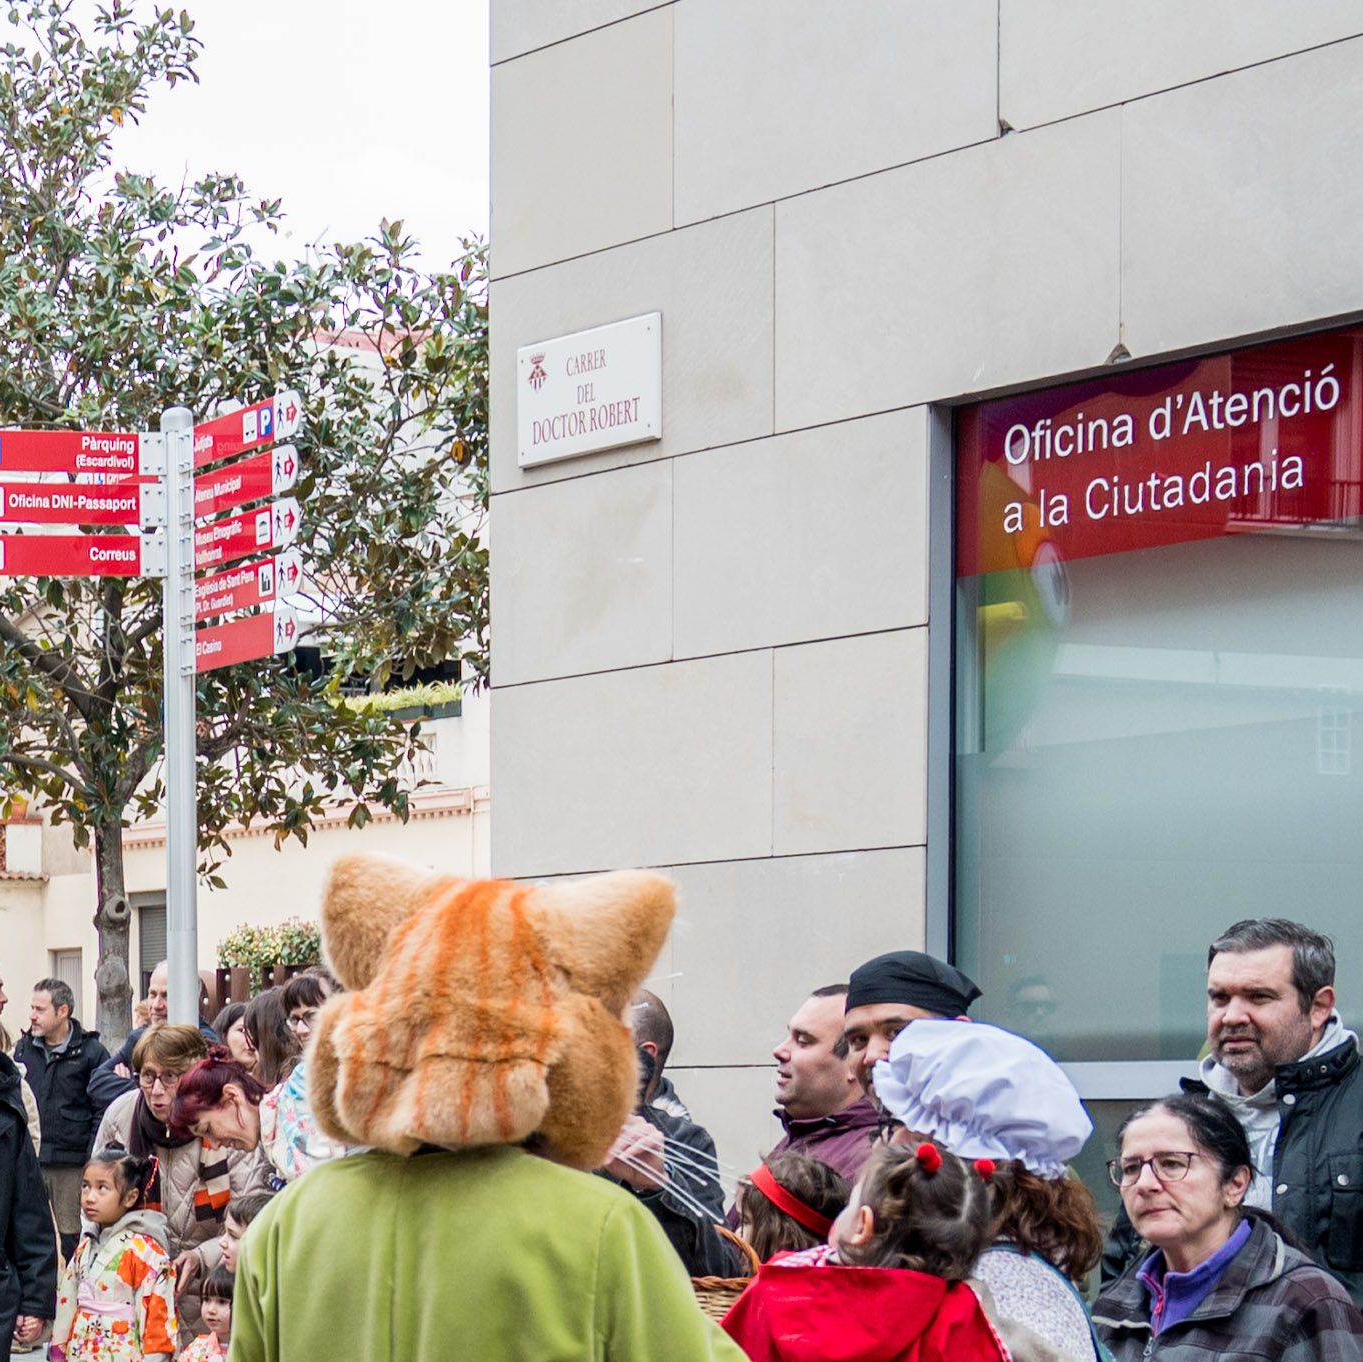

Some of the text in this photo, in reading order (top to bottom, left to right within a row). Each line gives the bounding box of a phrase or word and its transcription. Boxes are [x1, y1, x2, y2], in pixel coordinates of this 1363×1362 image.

[566, 349, 607, 377] CARRER
[577, 383, 596, 405] DEL
[532, 396, 641, 445] DOCTOR ROBERT
[1004, 363, 1340, 465] Oficina d'Atenció
[82, 436, 135, 454] Pàrquing
[9, 494, 50, 509] Oficina
[52, 495, 137, 512] DNI-Passaport
[1003, 448, 1304, 534] a la Ciutadania
[89, 547, 136, 561] Correus
